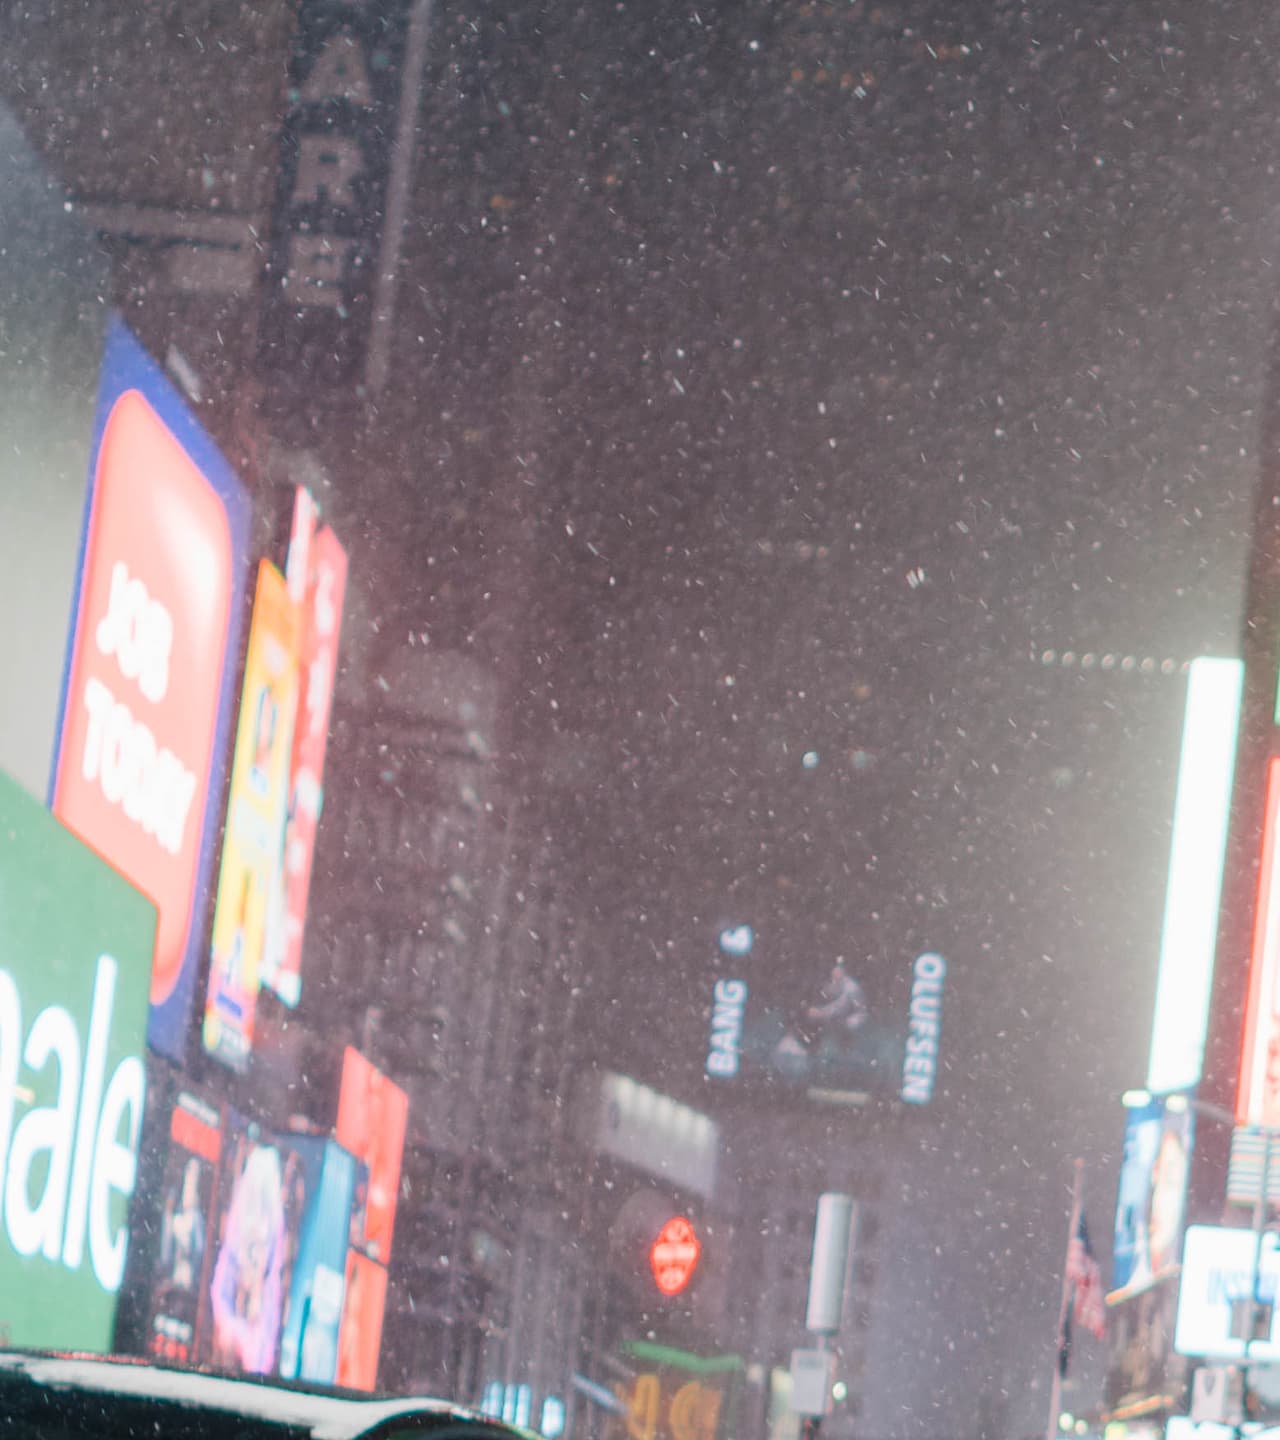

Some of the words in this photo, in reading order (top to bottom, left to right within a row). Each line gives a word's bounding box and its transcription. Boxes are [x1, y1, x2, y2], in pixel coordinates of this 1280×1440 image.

[96, 561, 173, 703] JOB
[83, 676, 197, 855] TODAY
[719, 925, 753, 956] &
[706, 979, 747, 1077] BANG
[902, 951, 946, 1105] OLUFSEN
